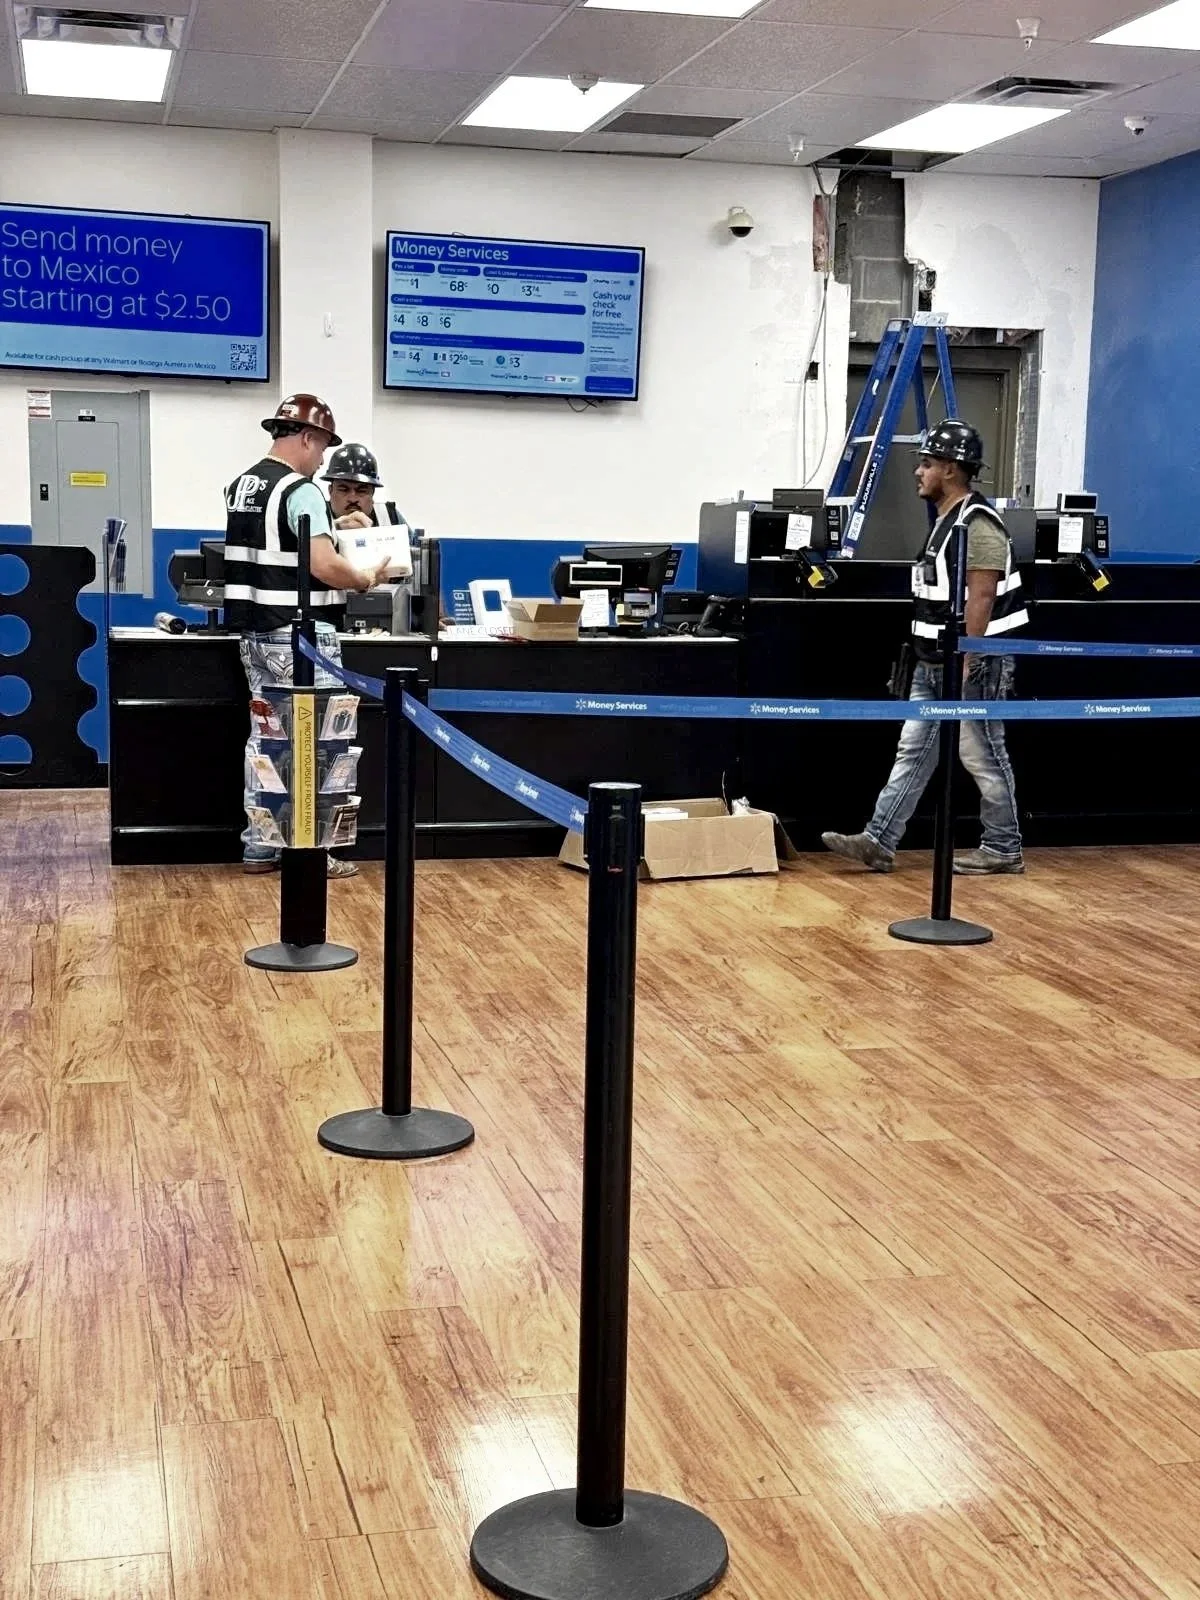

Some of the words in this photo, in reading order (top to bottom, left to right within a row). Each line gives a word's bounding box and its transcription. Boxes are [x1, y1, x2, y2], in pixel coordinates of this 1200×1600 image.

[2, 222, 76, 252] Send
[86, 233, 183, 264] money
[395, 240, 445, 259] Money
[448, 244, 509, 261] Services
[2, 255, 31, 279] to
[41, 256, 140, 286] Mexico
[2, 286, 113, 319] starting
[122, 293, 147, 316] at
[155, 290, 231, 321] $2.50
[593, 291, 613, 300] Cash
[614, 293, 632, 301] your
[592, 300, 616, 309] check
[592, 309, 605, 318] for
[605, 311, 622, 319] free
[103, 358, 129, 366] Walmart
[863, 461, 879, 506] LOUISVILLE
[1046, 645, 1063, 653] Money
[587, 700, 615, 711] Money
[616, 701, 648, 711] Services
[761, 705, 788, 715] Money
[788, 706, 820, 715] Services
[930, 707, 957, 716] Money
[957, 706, 988, 715] Services
[1095, 704, 1121, 714] Money
[1121, 704, 1151, 713] Services
[304, 721, 312, 753] PROTECT
[304, 754, 312, 788] YOURSELF
[304, 789, 312, 811] FROM
[304, 812, 312, 836] FRAUD
